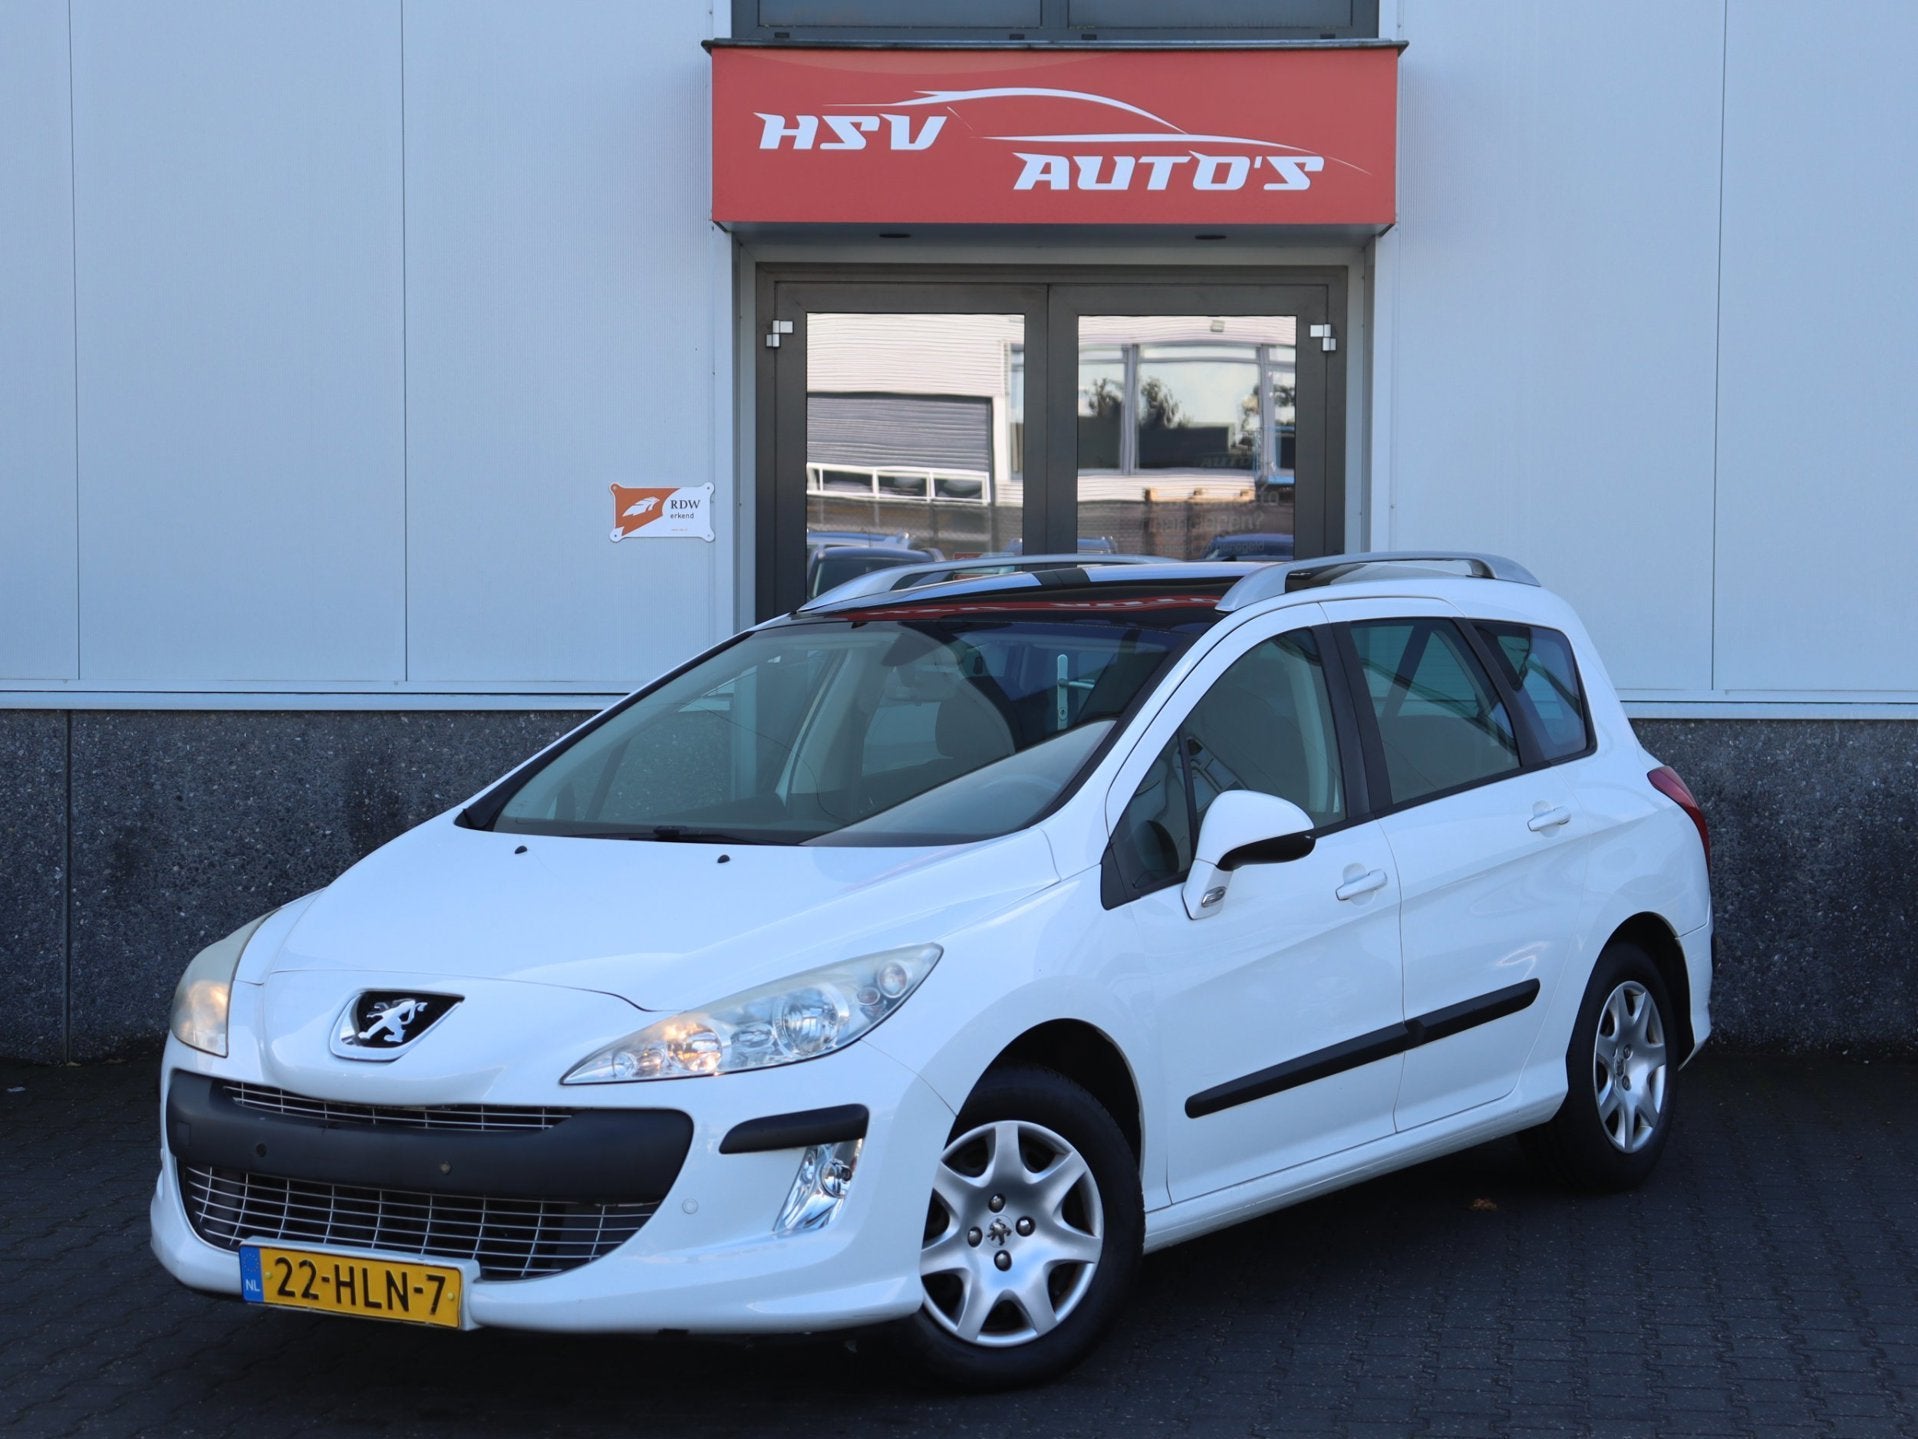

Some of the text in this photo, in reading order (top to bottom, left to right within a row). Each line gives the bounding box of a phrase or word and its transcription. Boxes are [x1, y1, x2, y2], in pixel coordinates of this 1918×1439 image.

[753, 112, 947, 151] HSV
[1012, 150, 1325, 191] AUTO'S
[670, 499, 701, 510] RDW
[245, 1279, 261, 1293] NL
[274, 1256, 447, 1316] 22-HLN-7
